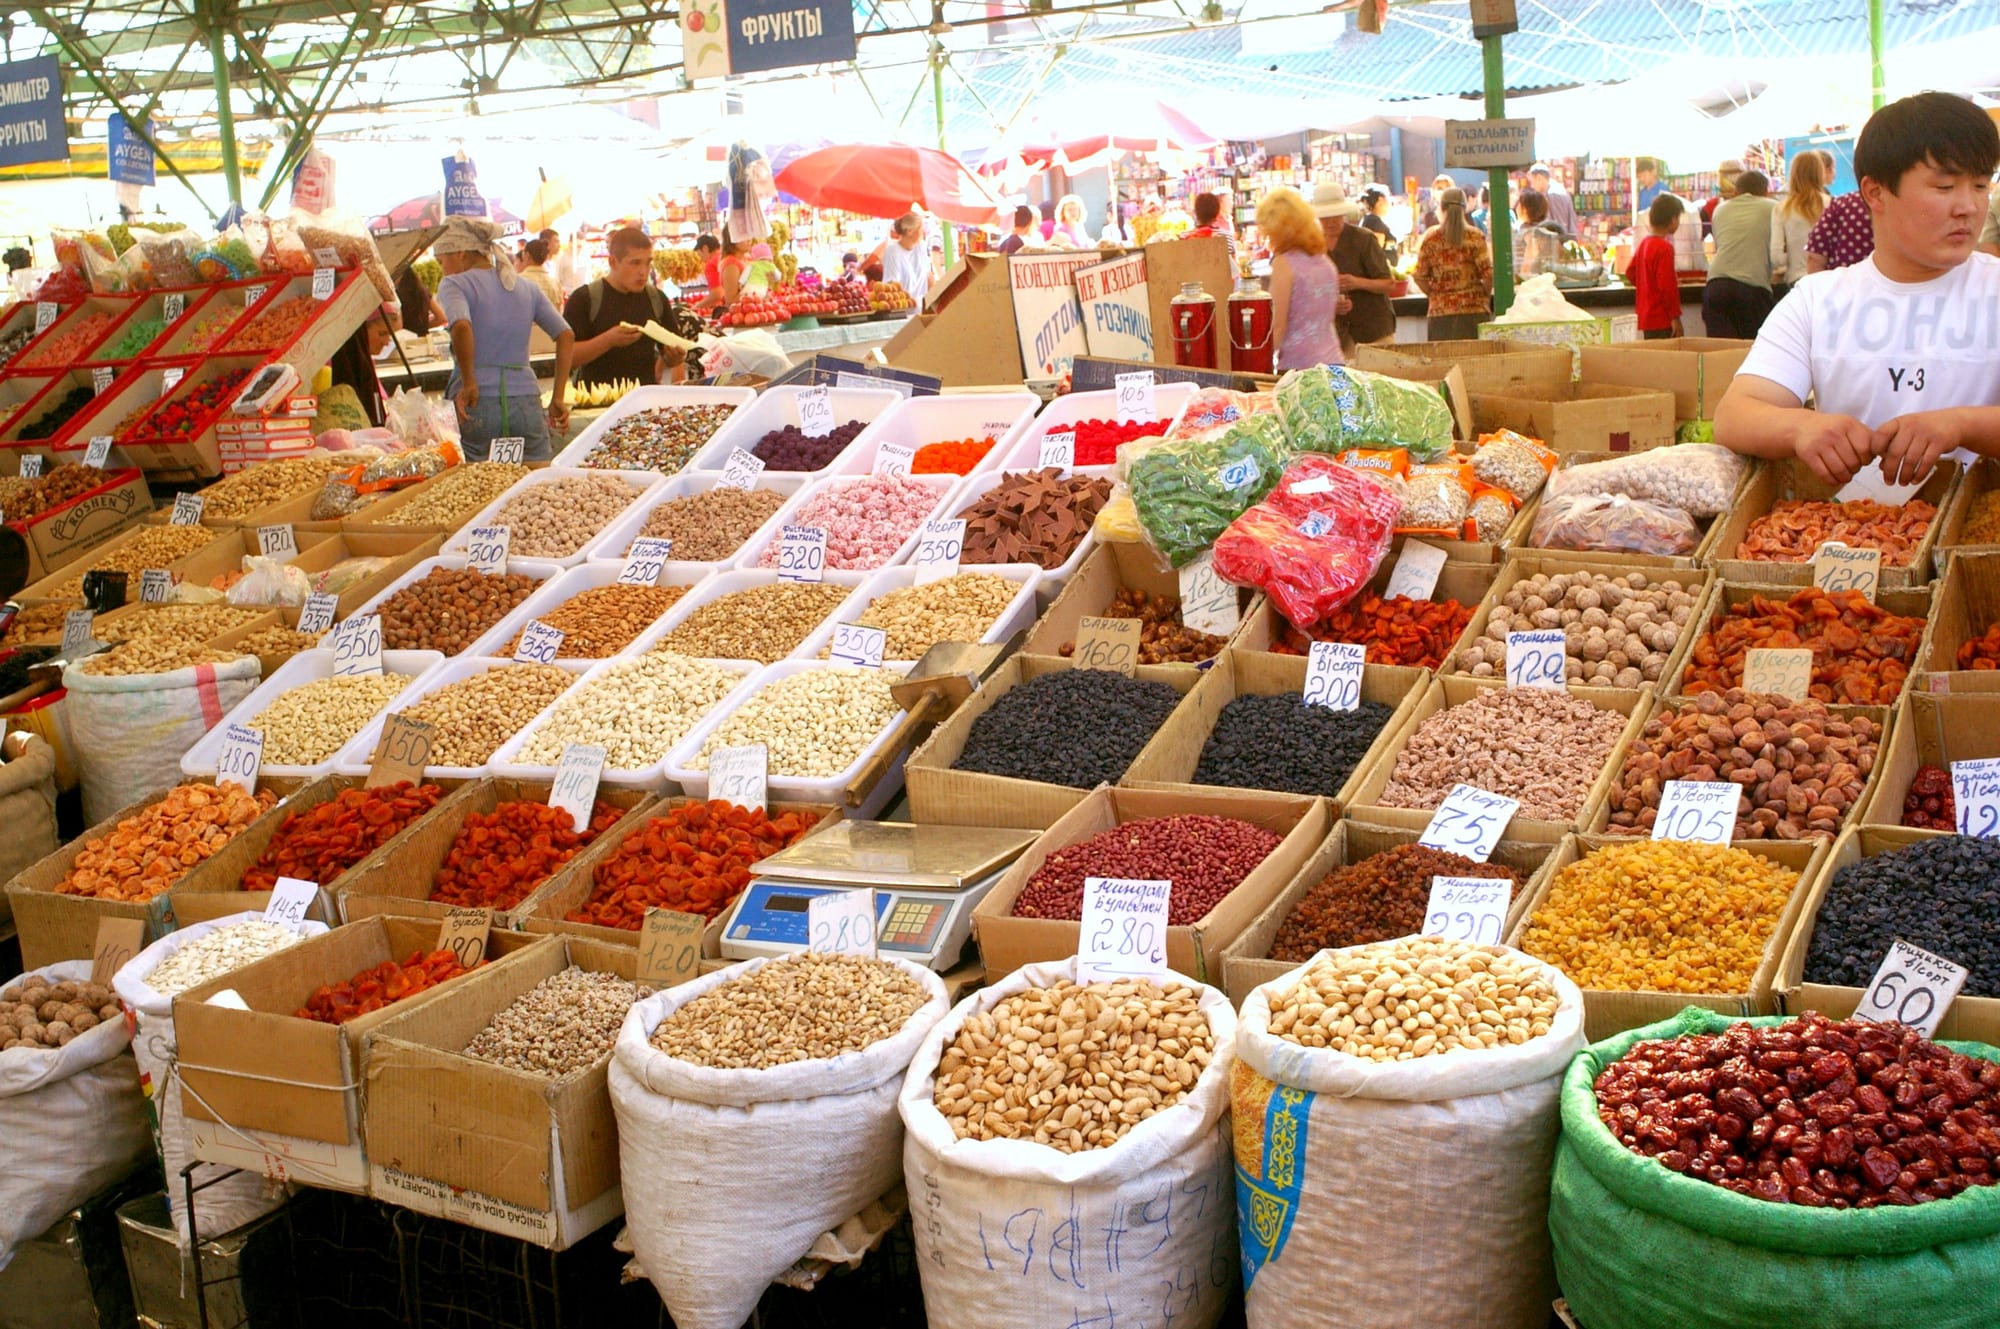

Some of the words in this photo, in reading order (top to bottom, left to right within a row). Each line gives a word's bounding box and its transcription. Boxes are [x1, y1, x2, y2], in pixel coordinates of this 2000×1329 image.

[741, 7, 822, 45] ФРУКТЫ
[1078, 274, 1097, 302] ИЕ
[1035, 299, 1085, 369] ОПТОМ
[1888, 367, 1925, 392] Y-3
[1119, 386, 1143, 403] 105
[495, 443, 522, 464] 350
[69, 497, 117, 527] ROSHEN
[469, 542, 503, 564] 300
[780, 546, 821, 570] 320
[918, 540, 958, 566] 350
[621, 560, 662, 582] 550
[333, 630, 378, 662] 350
[518, 635, 554, 663] 350
[1302, 676, 1356, 708] 200
[382, 727, 429, 767] 150
[221, 747, 256, 777] 180
[1658, 804, 1732, 841] 105
[814, 914, 871, 953] 280
[644, 939, 694, 975] 120
[1896, 942, 1956, 973] Финики
[401, 1181, 437, 1199] TİCARET
[484, 1204, 506, 1219] GIDA
